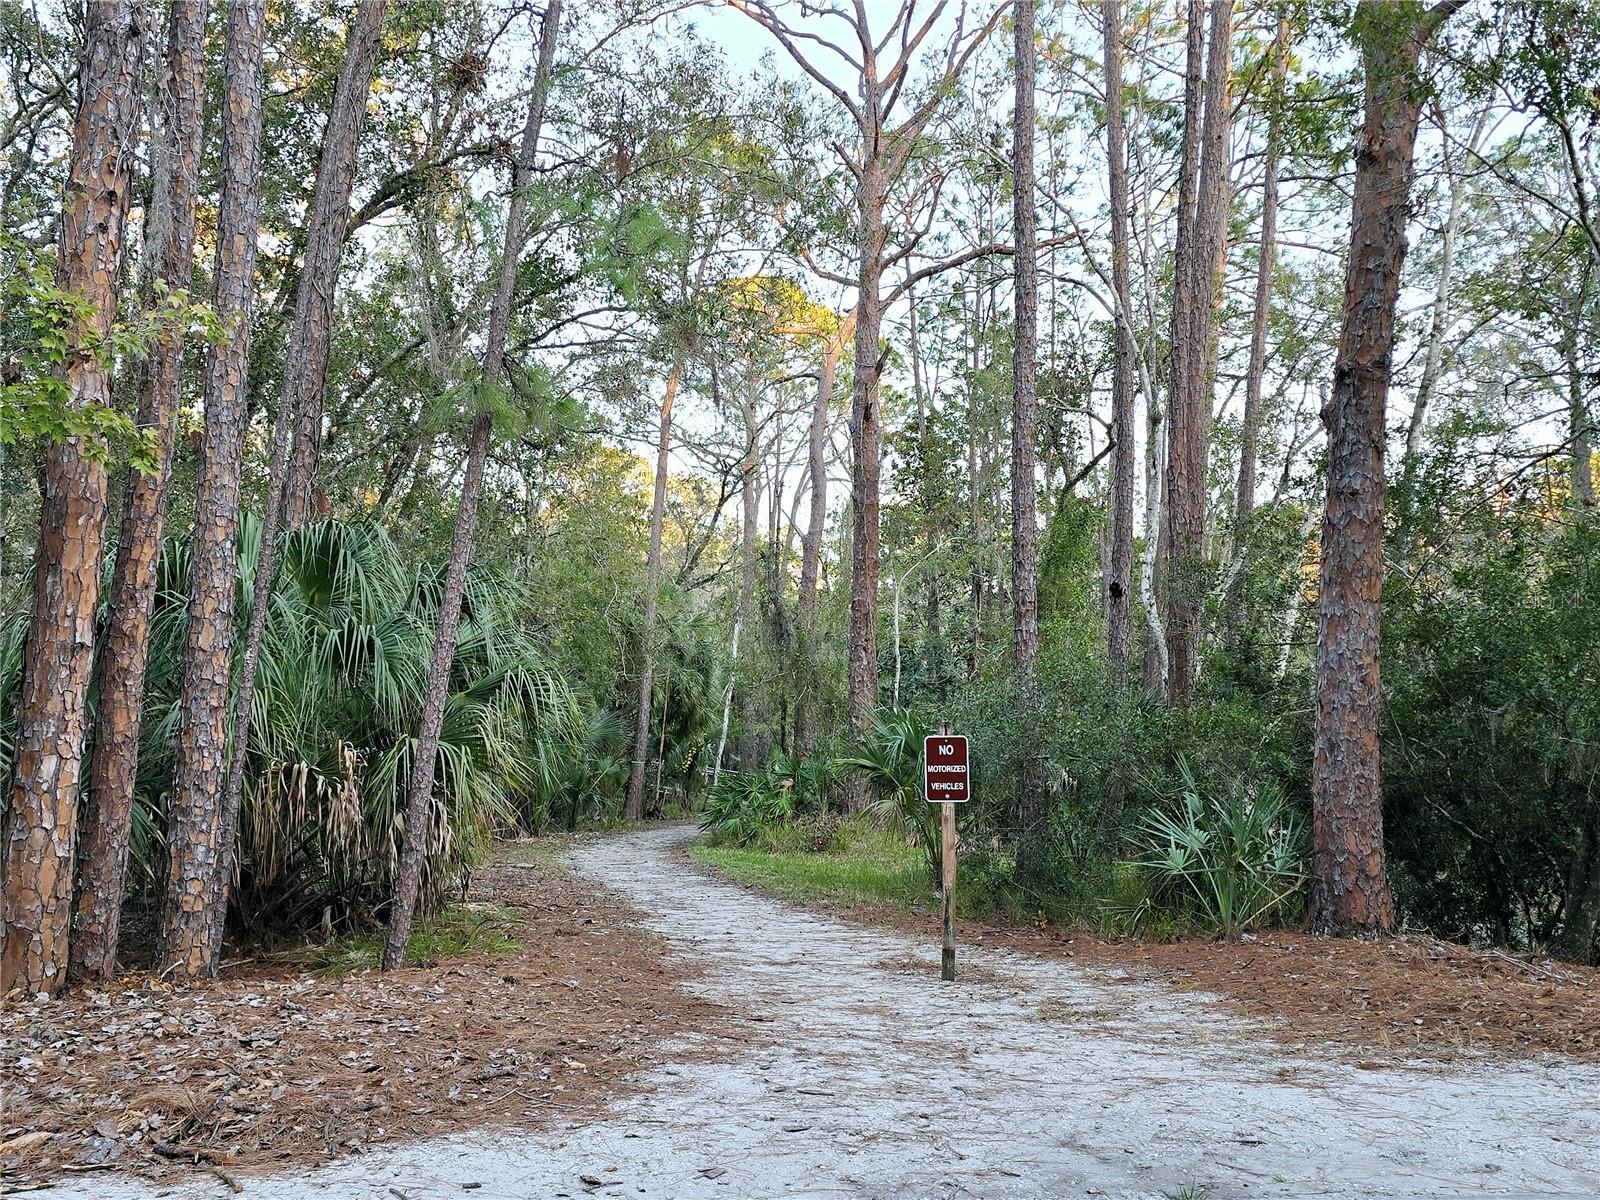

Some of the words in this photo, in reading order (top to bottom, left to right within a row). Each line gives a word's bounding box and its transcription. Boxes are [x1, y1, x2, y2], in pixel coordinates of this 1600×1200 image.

[938, 745, 954, 755] NO
[927, 765, 966, 773] MOTORIZED
[930, 782, 964, 790] VEHICLES
